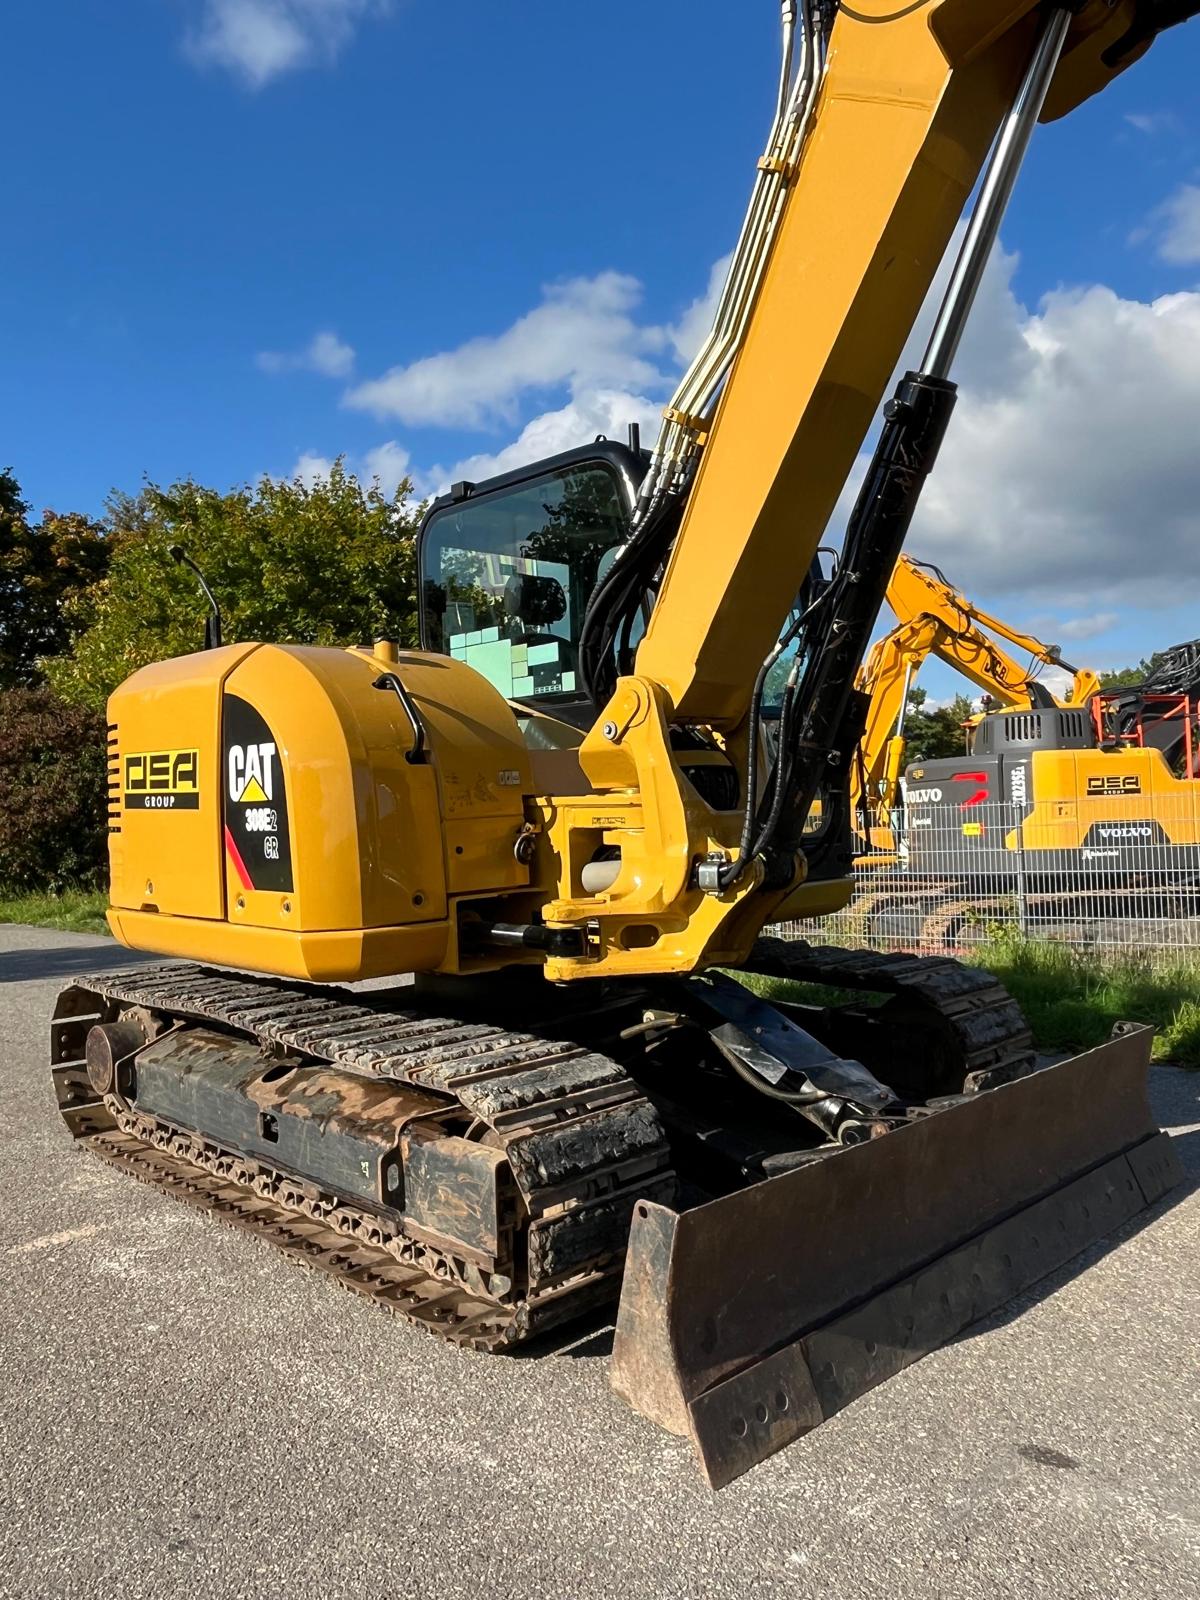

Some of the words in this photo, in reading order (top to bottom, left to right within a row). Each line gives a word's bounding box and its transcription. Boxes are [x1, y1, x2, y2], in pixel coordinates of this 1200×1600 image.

[228, 742, 275, 802] CAT
[144, 795, 175, 808] GROUP
[1098, 827, 1153, 838] VOLVO
[264, 835, 279, 860] CR
